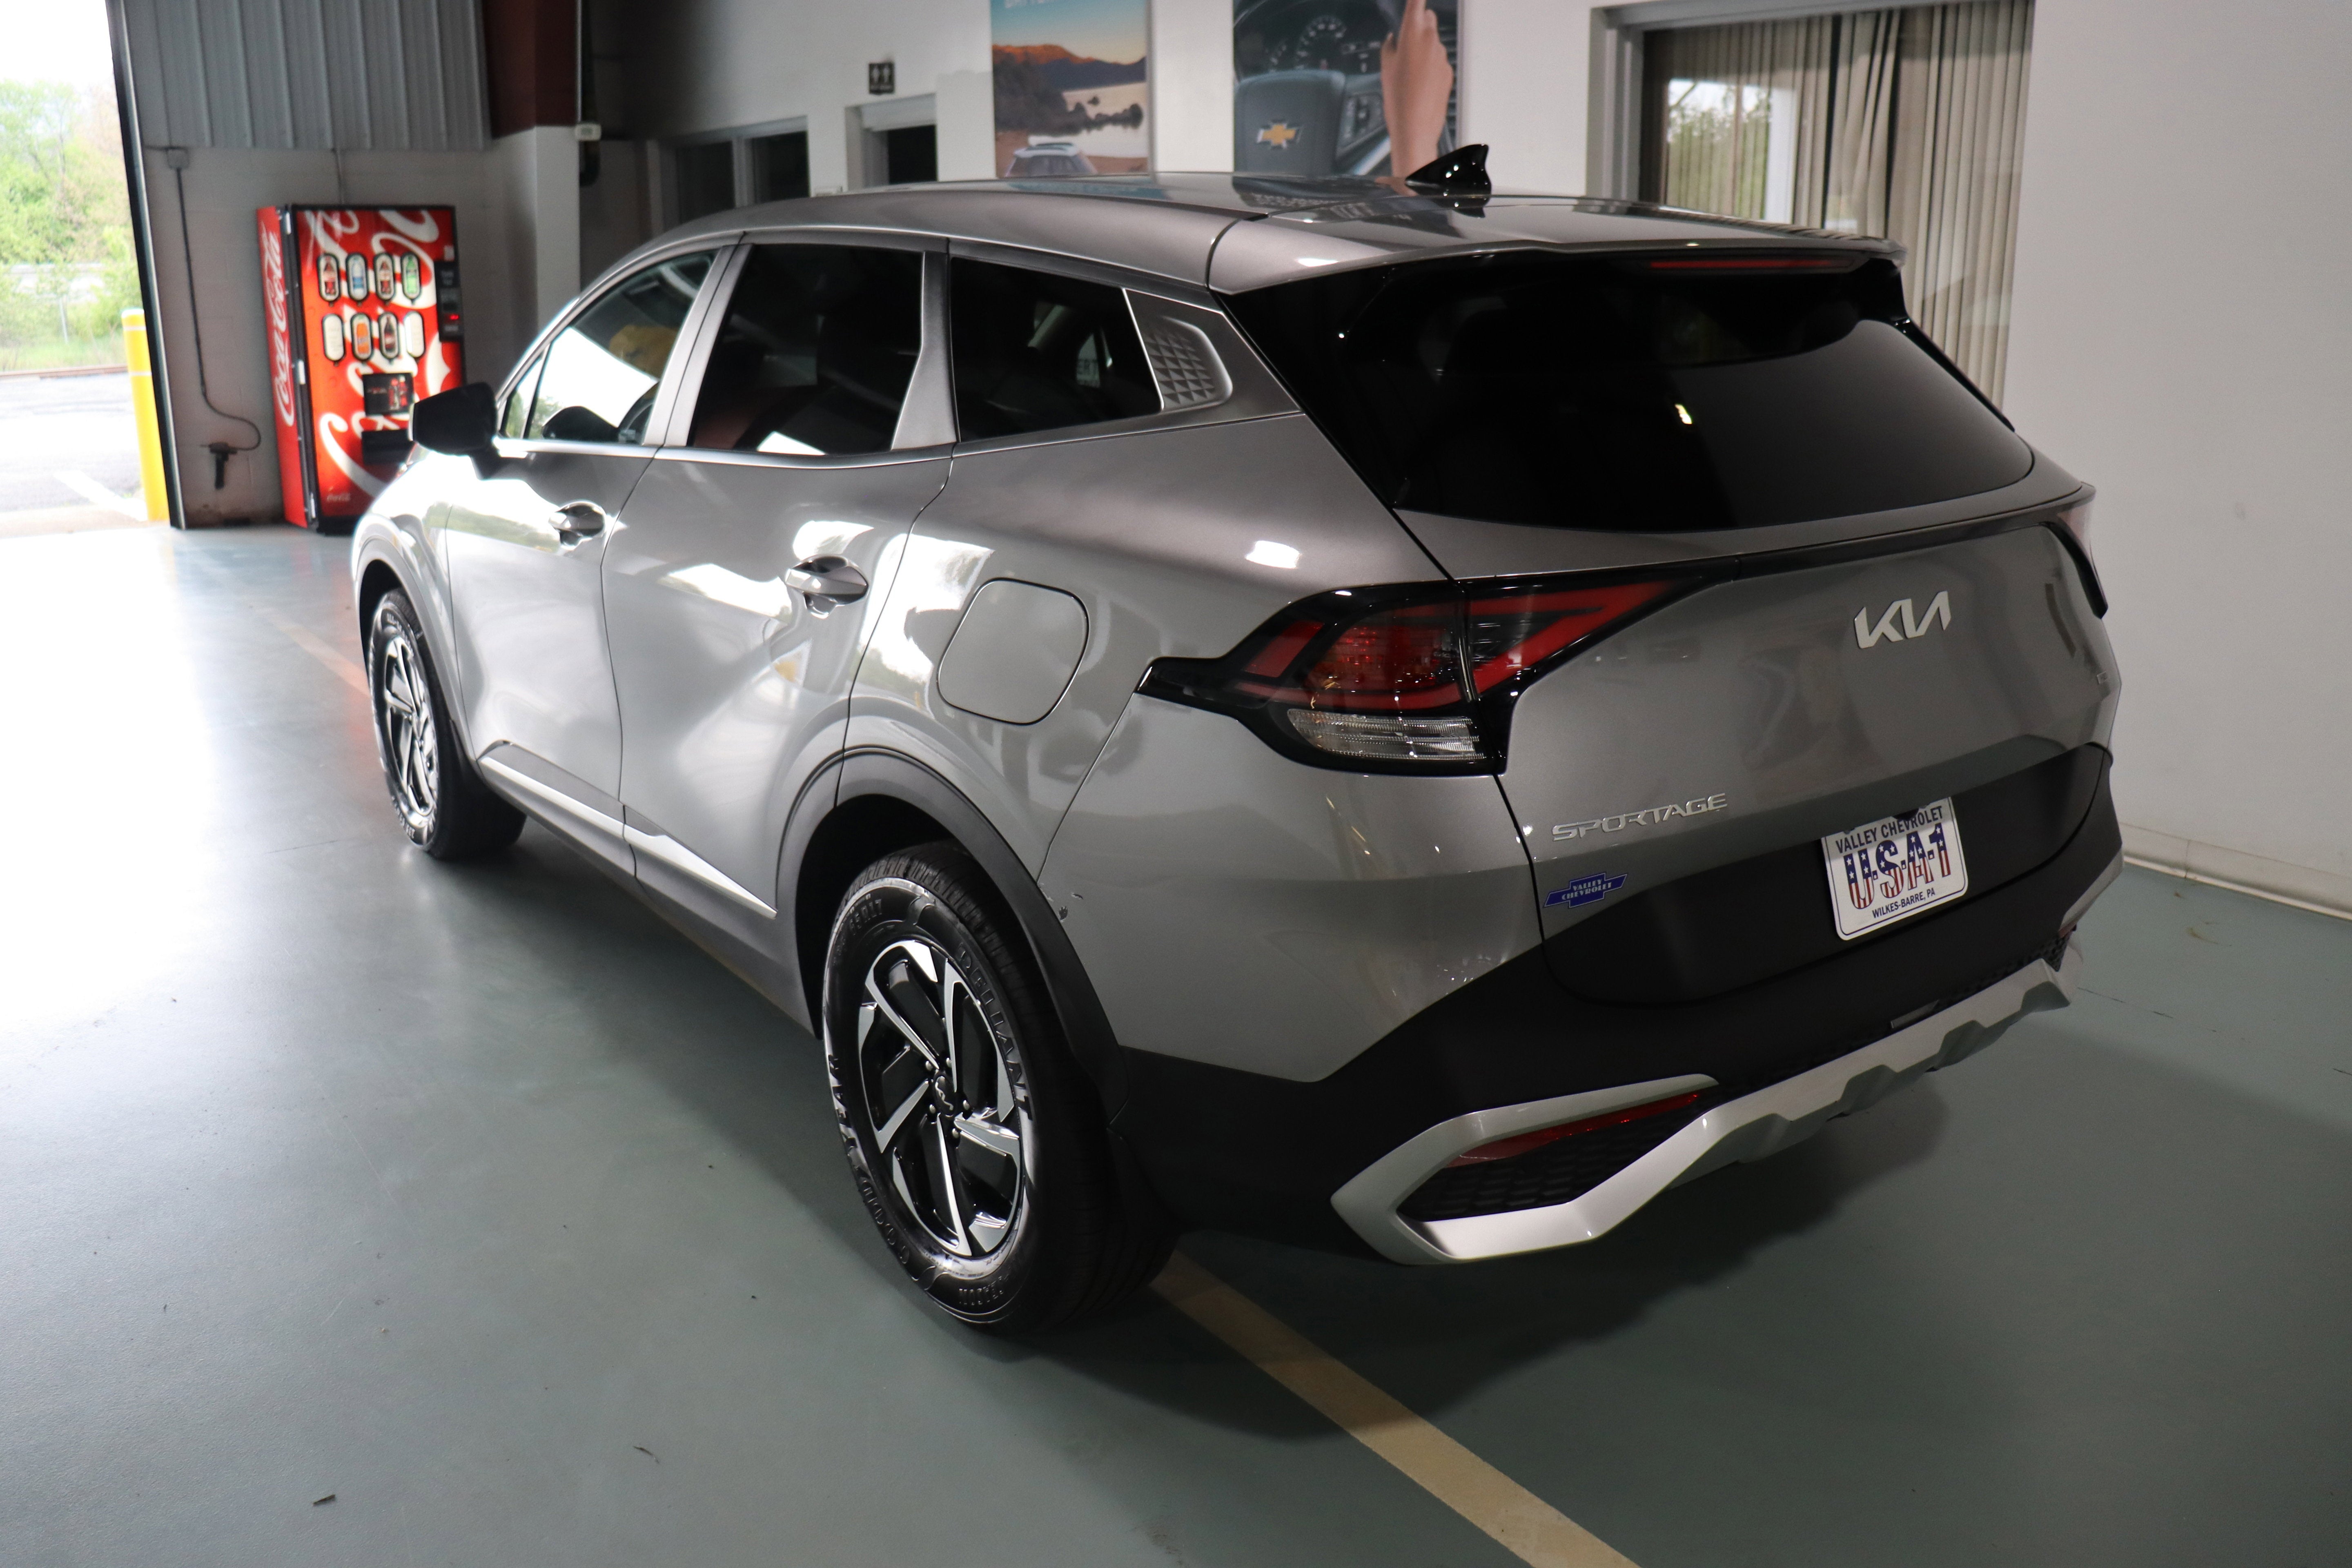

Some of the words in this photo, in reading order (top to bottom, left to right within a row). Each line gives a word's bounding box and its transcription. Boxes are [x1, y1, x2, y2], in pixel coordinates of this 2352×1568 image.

[1552, 793, 1728, 841] SPORTAGE
[1836, 827, 1877, 853] VALLEY
[1881, 806, 1943, 838] CHEVROLET
[1562, 882, 1612, 900] CHEVROLET
[1573, 879, 1602, 891] VALLEY
[1872, 892, 1926, 918] WILKES-BARRE,
[1927, 887, 1936, 898] PA
